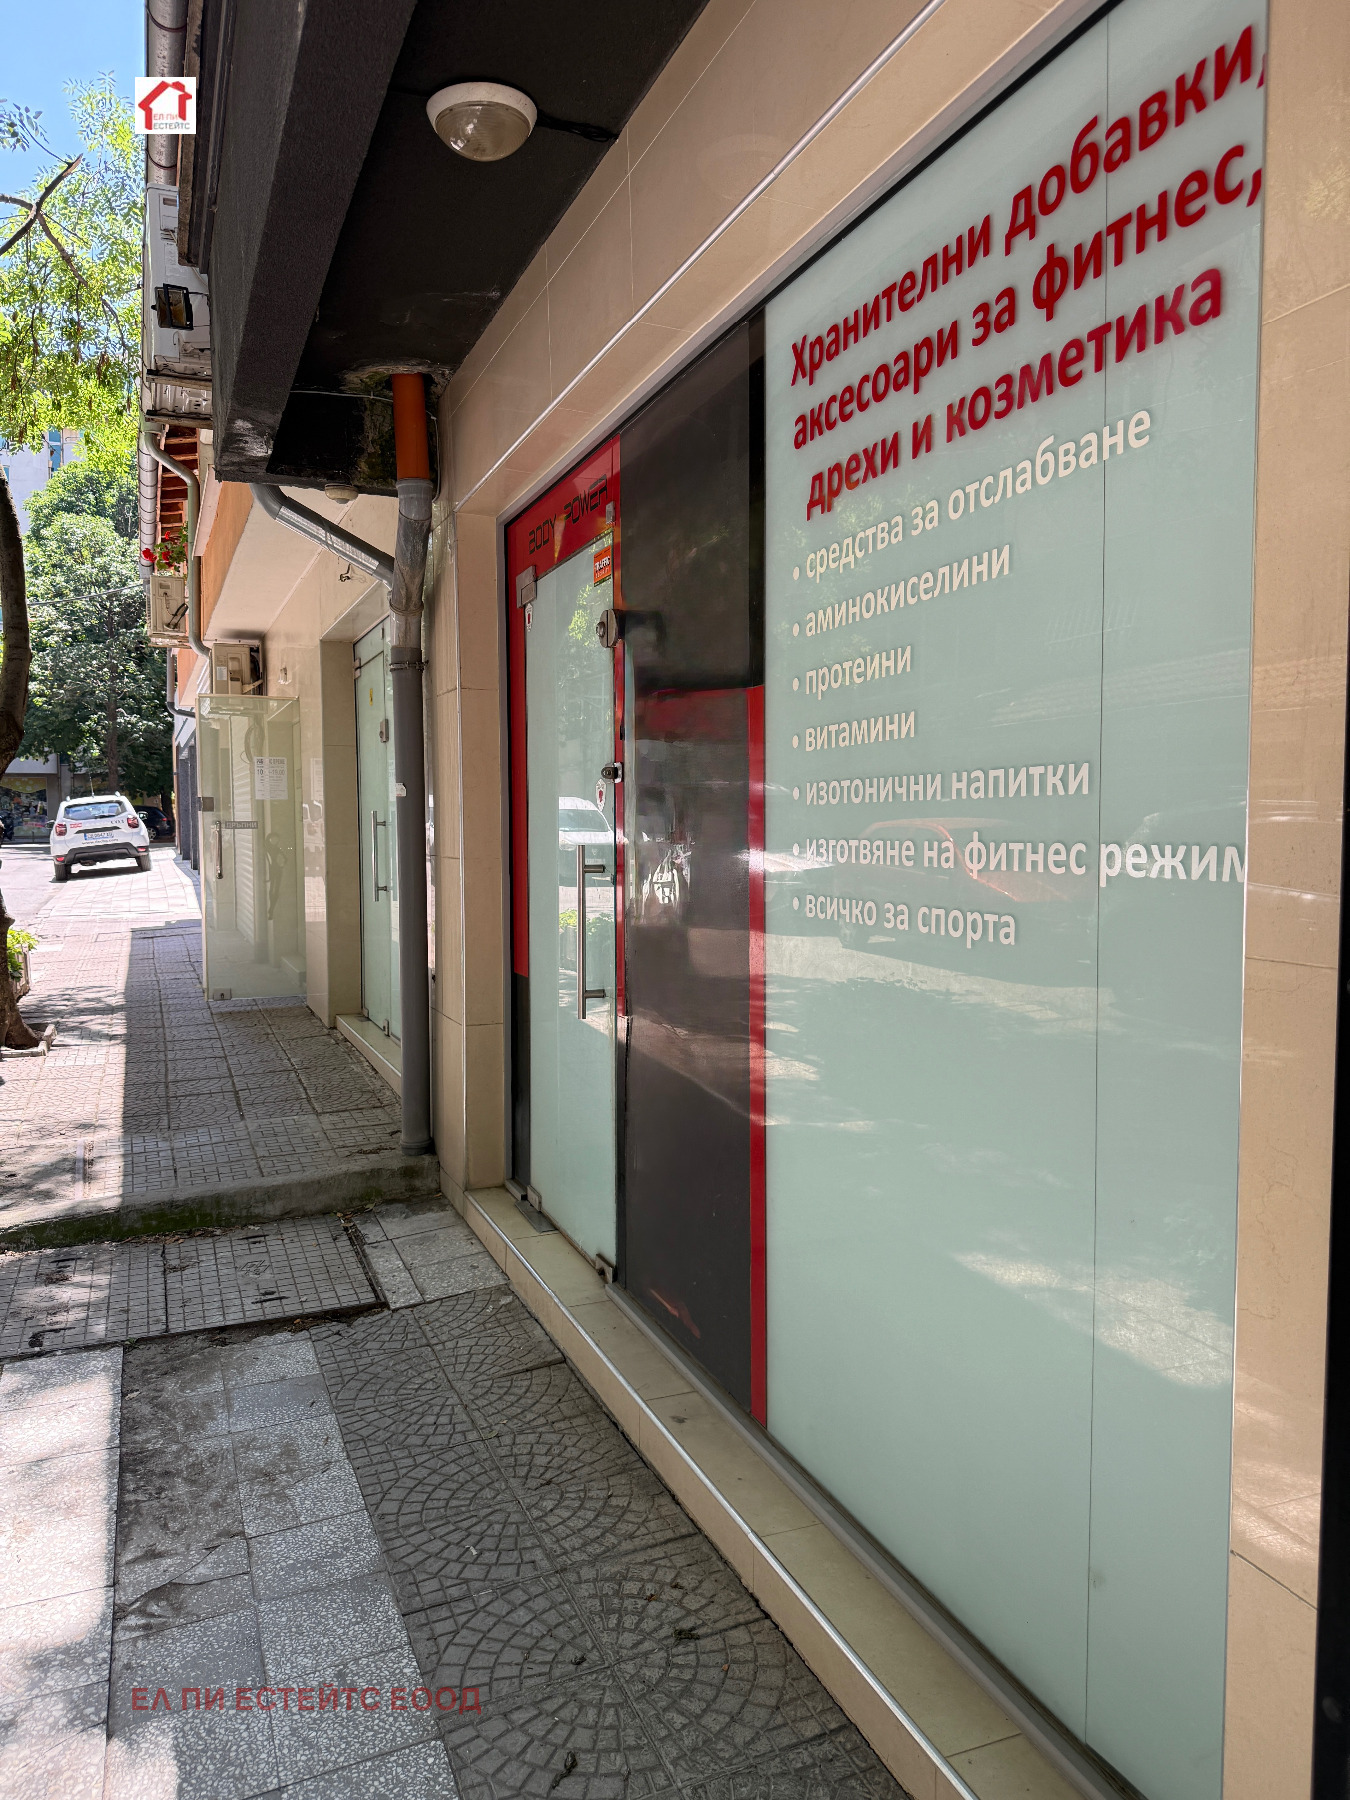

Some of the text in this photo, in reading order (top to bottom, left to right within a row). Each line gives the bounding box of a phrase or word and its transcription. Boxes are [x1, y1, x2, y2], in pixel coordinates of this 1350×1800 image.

[790, 25, 1264, 387] Хранителни добавки,
[793, 144, 1263, 451] аксесоари за фитнес,
[806, 268, 1223, 521] дрехи и козметика
[529, 475, 608, 554] BODY POWER
[805, 410, 1151, 584] средства за отслабване
[804, 544, 1011, 638] аминокиселини
[805, 645, 912, 700] протеини
[805, 711, 916, 752] витамини
[806, 763, 1089, 806] изотонични напитки
[805, 836, 915, 868] изготвяне
[923, 840, 954, 870] на
[964, 831, 1086, 877] фитнес
[805, 895, 1016, 951] всичко за спорта
